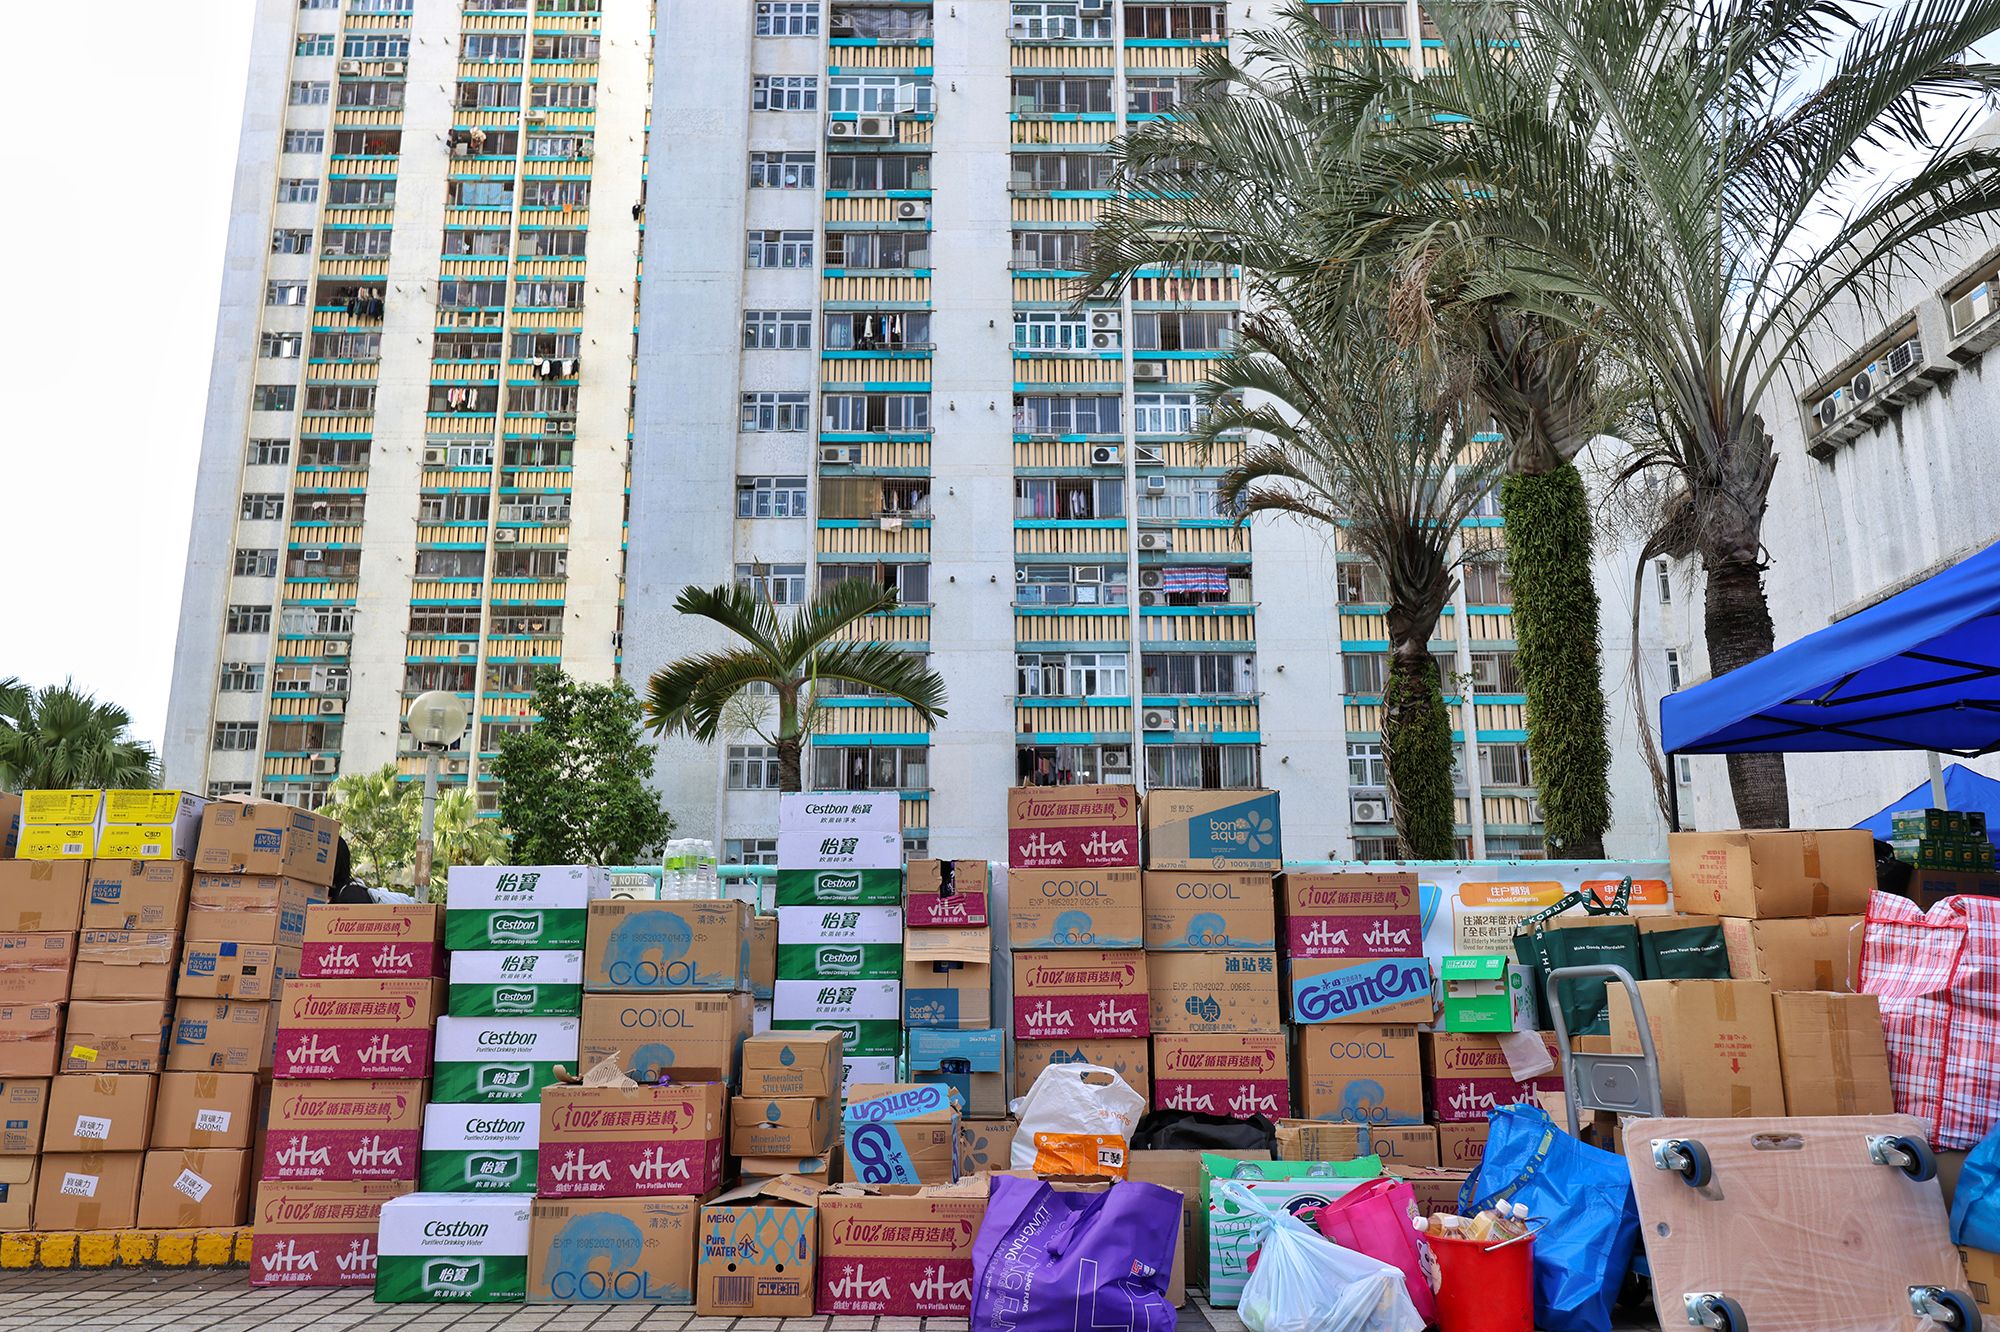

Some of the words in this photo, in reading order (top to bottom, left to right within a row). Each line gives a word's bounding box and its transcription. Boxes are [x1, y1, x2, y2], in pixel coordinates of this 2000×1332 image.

[851, 804, 873, 814] 怡寶
[1210, 818, 1236, 831] bon
[820, 837, 859, 855] 怡寶
[1019, 832, 1067, 857] vita
[1080, 830, 1128, 855] vita
[1210, 831, 1246, 843] aqua
[496, 873, 540, 892] 怡寶
[619, 876, 648, 885] NOTICE
[1042, 880, 1107, 897] COOL
[1176, 883, 1240, 899] COOL
[928, 897, 967, 916] vita
[821, 912, 860, 929] 怡寶
[1301, 920, 1349, 946] vita
[1362, 919, 1411, 945] vita
[319, 945, 359, 967] vita
[371, 945, 413, 967] vita
[502, 956, 538, 971] 怡寶
[1225, 957, 1273, 972] 油站裝
[1540, 949, 1552, 974] THE
[609, 961, 709, 985] COOL
[816, 987, 857, 1004] 怡寶
[1297, 964, 1428, 1020] Ganten
[620, 1008, 694, 1027] COOL
[1024, 1000, 1074, 1026] vita
[1088, 999, 1138, 1026] vita
[1185, 994, 1221, 1022] 甘泉
[478, 1030, 537, 1045] C'estbon
[286, 1034, 340, 1064] vita
[357, 1034, 412, 1064] vita
[1330, 1042, 1394, 1058] COOL
[493, 1072, 520, 1085] 怡寶
[763, 1074, 803, 1083] Mineralized
[762, 1084, 777, 1093] STILL
[780, 1084, 804, 1093] WATER
[1165, 1084, 1214, 1111] vita
[1228, 1084, 1278, 1111] vita
[1448, 1082, 1497, 1110] vita
[1511, 1082, 1538, 1108] vit
[851, 1087, 940, 1122] Ganten
[76, 1129, 101, 1138] 500ML
[198, 1123, 223, 1132] 500ML
[466, 1119, 525, 1133] C'estbon
[751, 1135, 790, 1143] Mineralized
[275, 1135, 331, 1166] vita
[347, 1135, 403, 1166] vita
[768, 1145, 791, 1153] WATER
[480, 1161, 508, 1174] 怡寶
[551, 1148, 612, 1181] vita
[629, 1146, 690, 1180] vita
[63, 1187, 89, 1196] 500ML
[175, 1181, 198, 1199] 500ML
[707, 1214, 735, 1223] MEKO
[1023, 1205, 1049, 1236] LUNG
[424, 1221, 489, 1237] C'estbon
[706, 1234, 725, 1245] Pure
[1005, 1234, 1029, 1260] FUNG
[261, 1239, 319, 1271] vita
[336, 1239, 377, 1271] vit
[706, 1246, 736, 1257] WATER
[439, 1268, 469, 1282] 怡寶
[828, 1263, 891, 1299] vita
[909, 1265, 972, 1300] vita
[551, 1271, 661, 1299] COOL
[999, 1296, 1020, 1332] FUN
